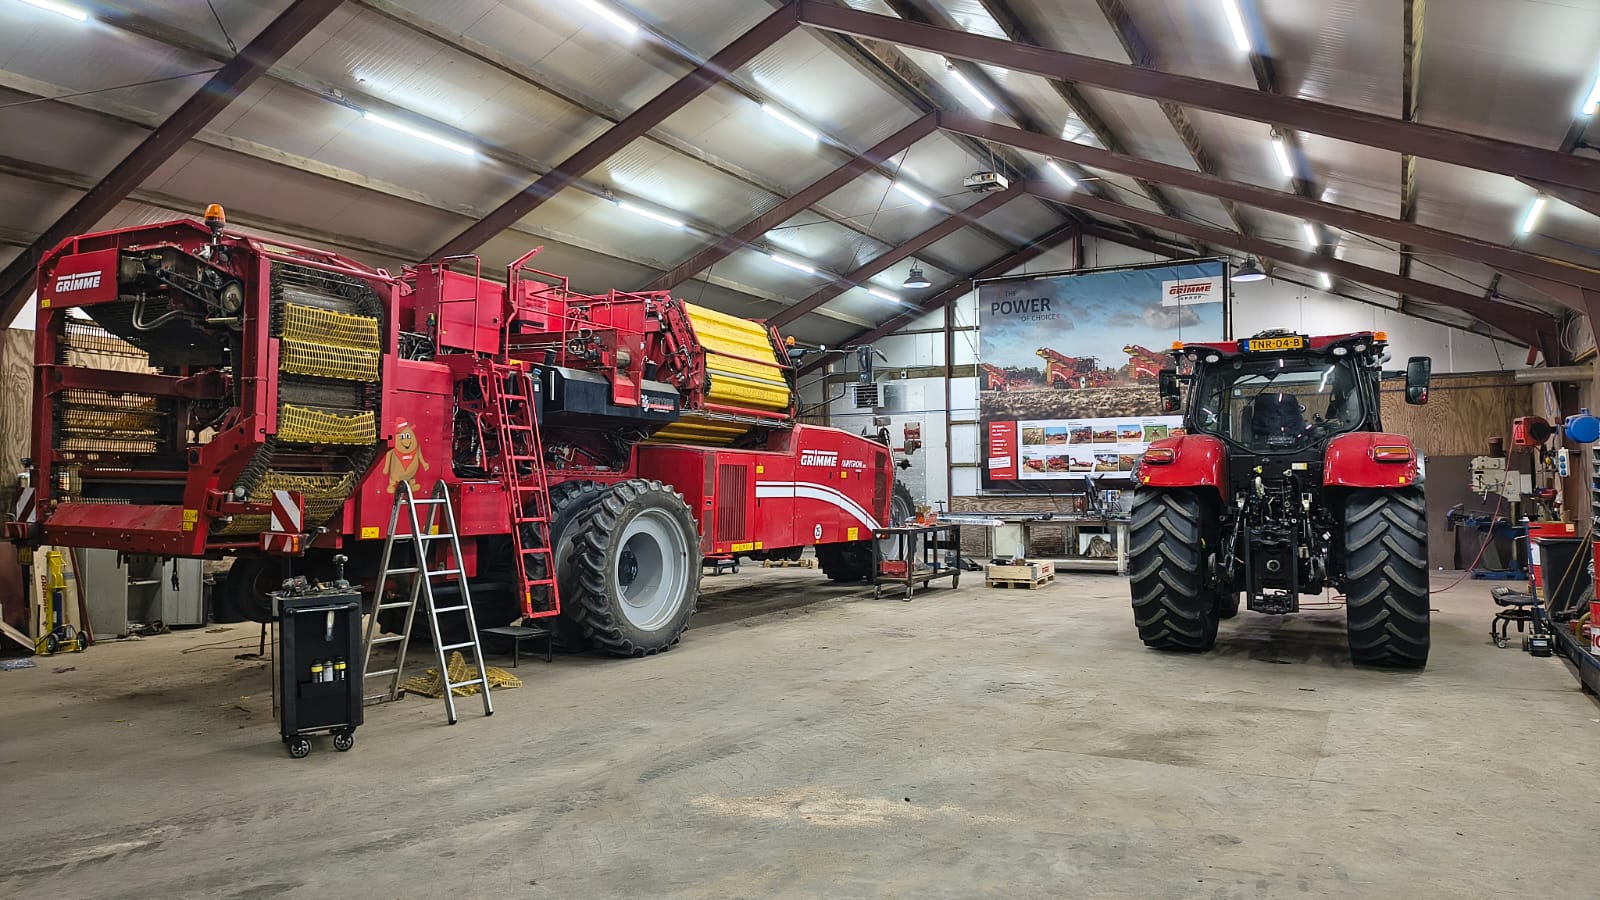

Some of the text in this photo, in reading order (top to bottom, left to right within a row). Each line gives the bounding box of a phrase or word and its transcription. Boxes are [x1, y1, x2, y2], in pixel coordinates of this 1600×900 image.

[56, 271, 102, 293] GRIMME
[1169, 283, 1212, 295] GRIMME
[991, 297, 1051, 316] POWER
[1252, 338, 1300, 349] TNR-04-B
[801, 450, 838, 467] GRIMME
